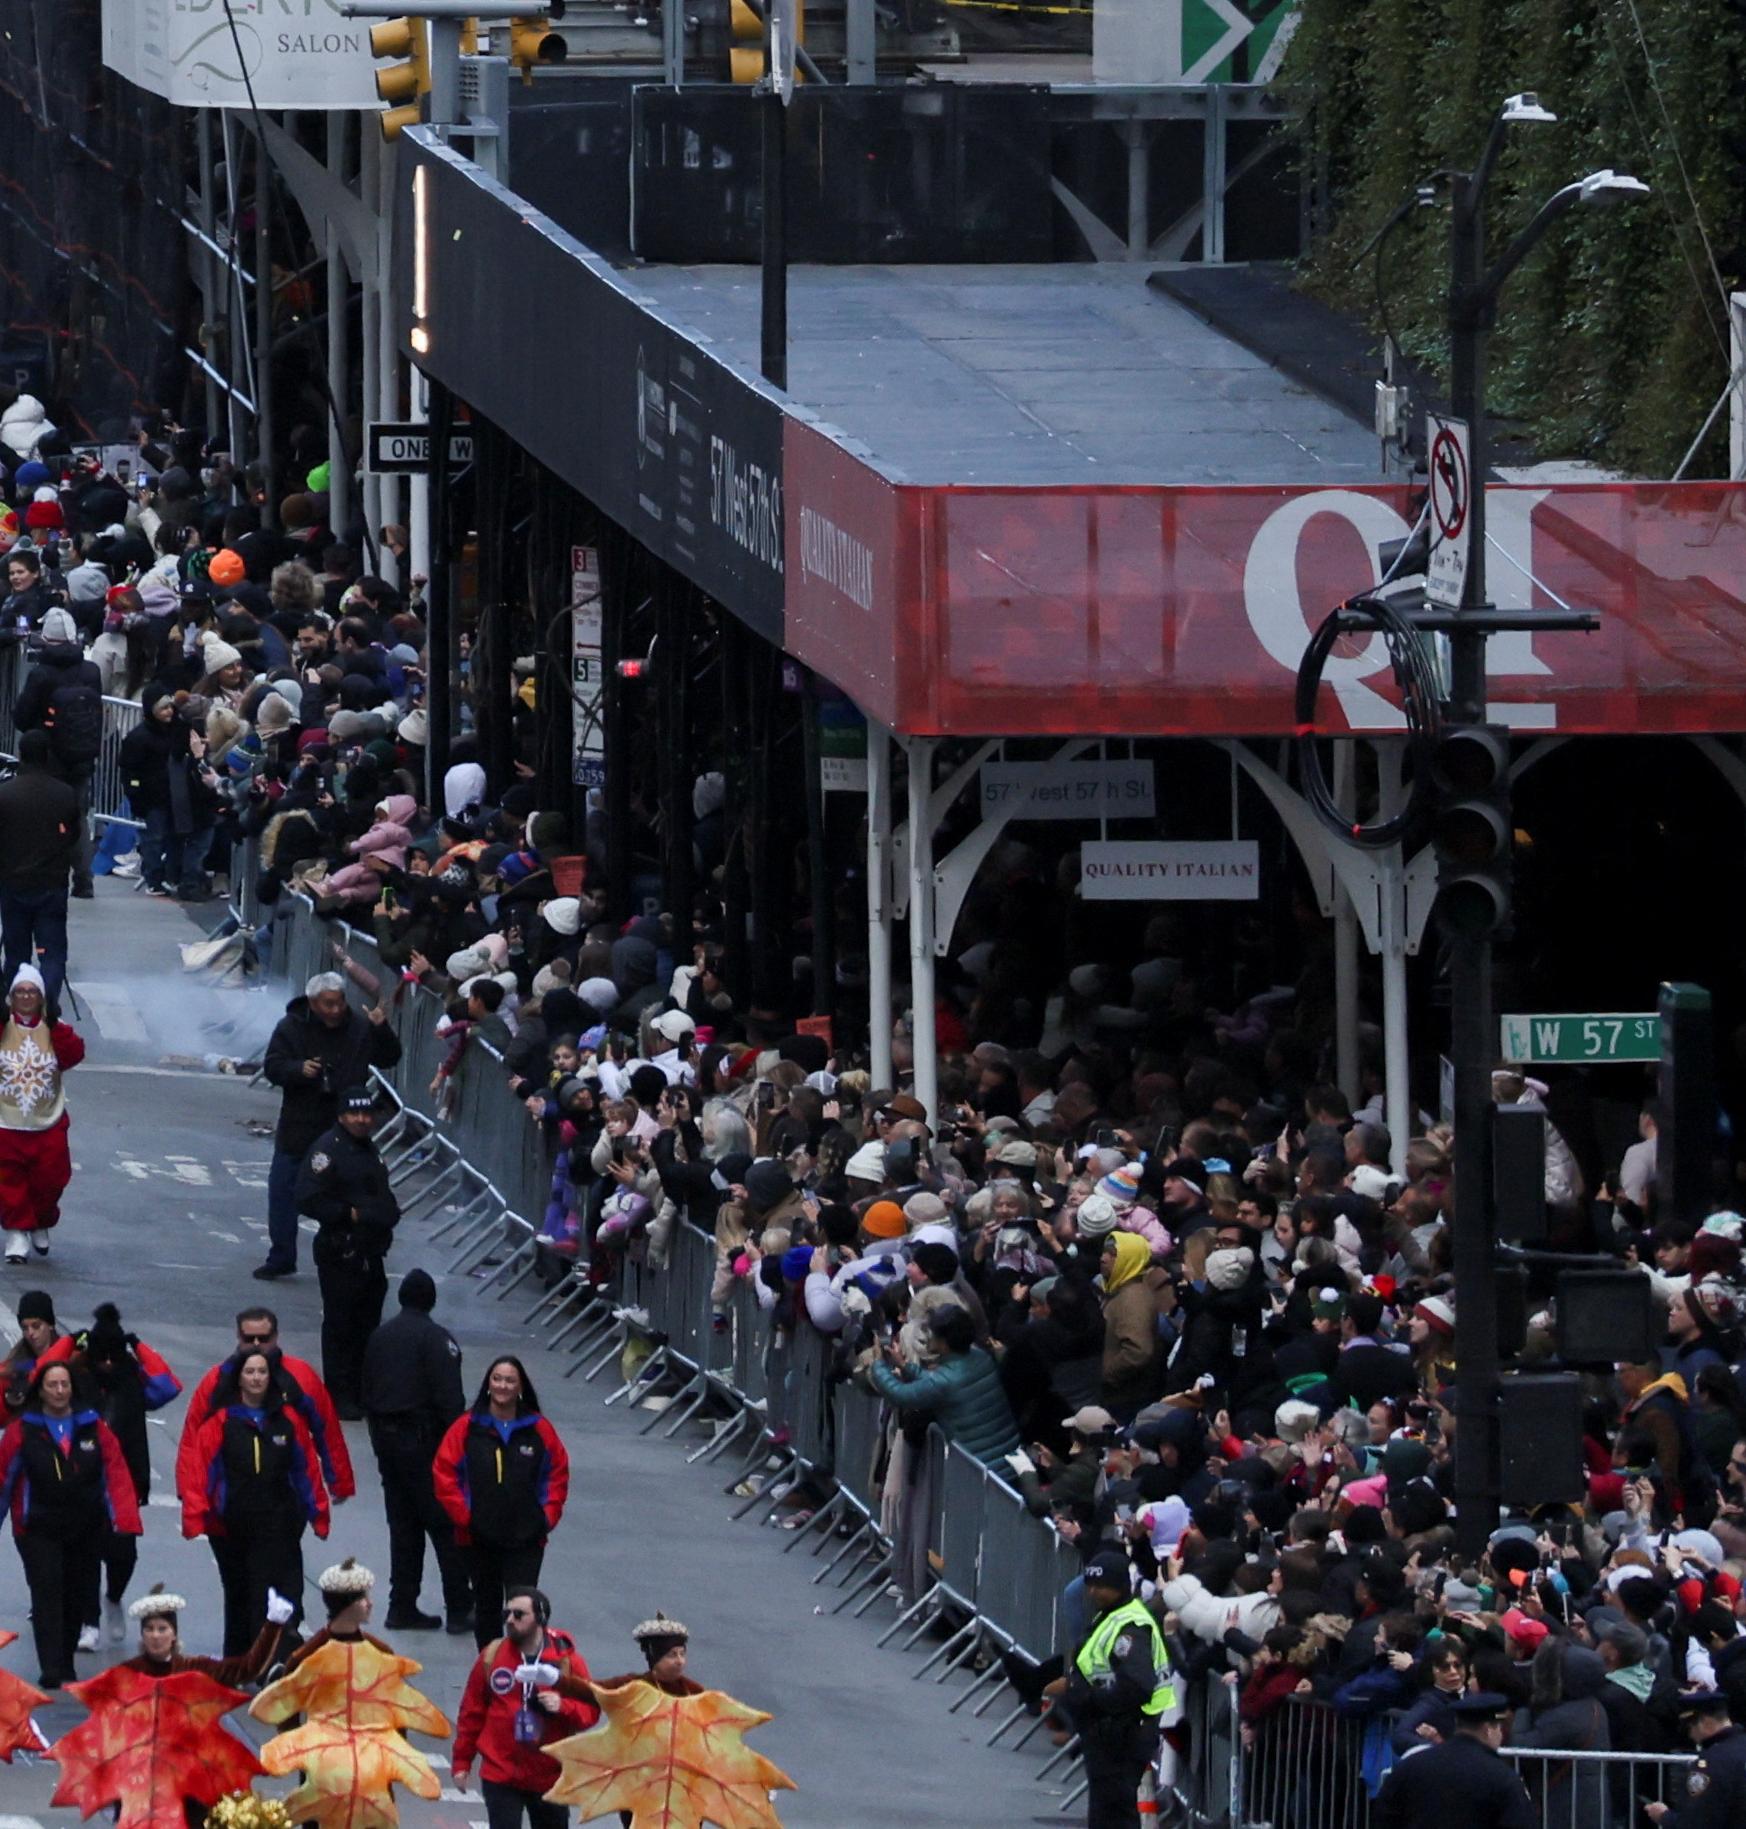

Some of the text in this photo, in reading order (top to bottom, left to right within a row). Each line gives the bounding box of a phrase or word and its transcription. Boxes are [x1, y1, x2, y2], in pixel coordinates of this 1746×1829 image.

[278, 34, 359, 53] SALON
[391, 439, 429, 459] ONE
[575, 551, 584, 571] 3
[577, 660, 586, 680] 5
[986, 783, 1008, 800] 57
[1016, 782, 1067, 800] est
[1076, 781, 1118, 798] 57h
[1086, 863, 1253, 878] QUALITY ITALIAN
[1536, 1021, 1654, 1056] W 57 ST
